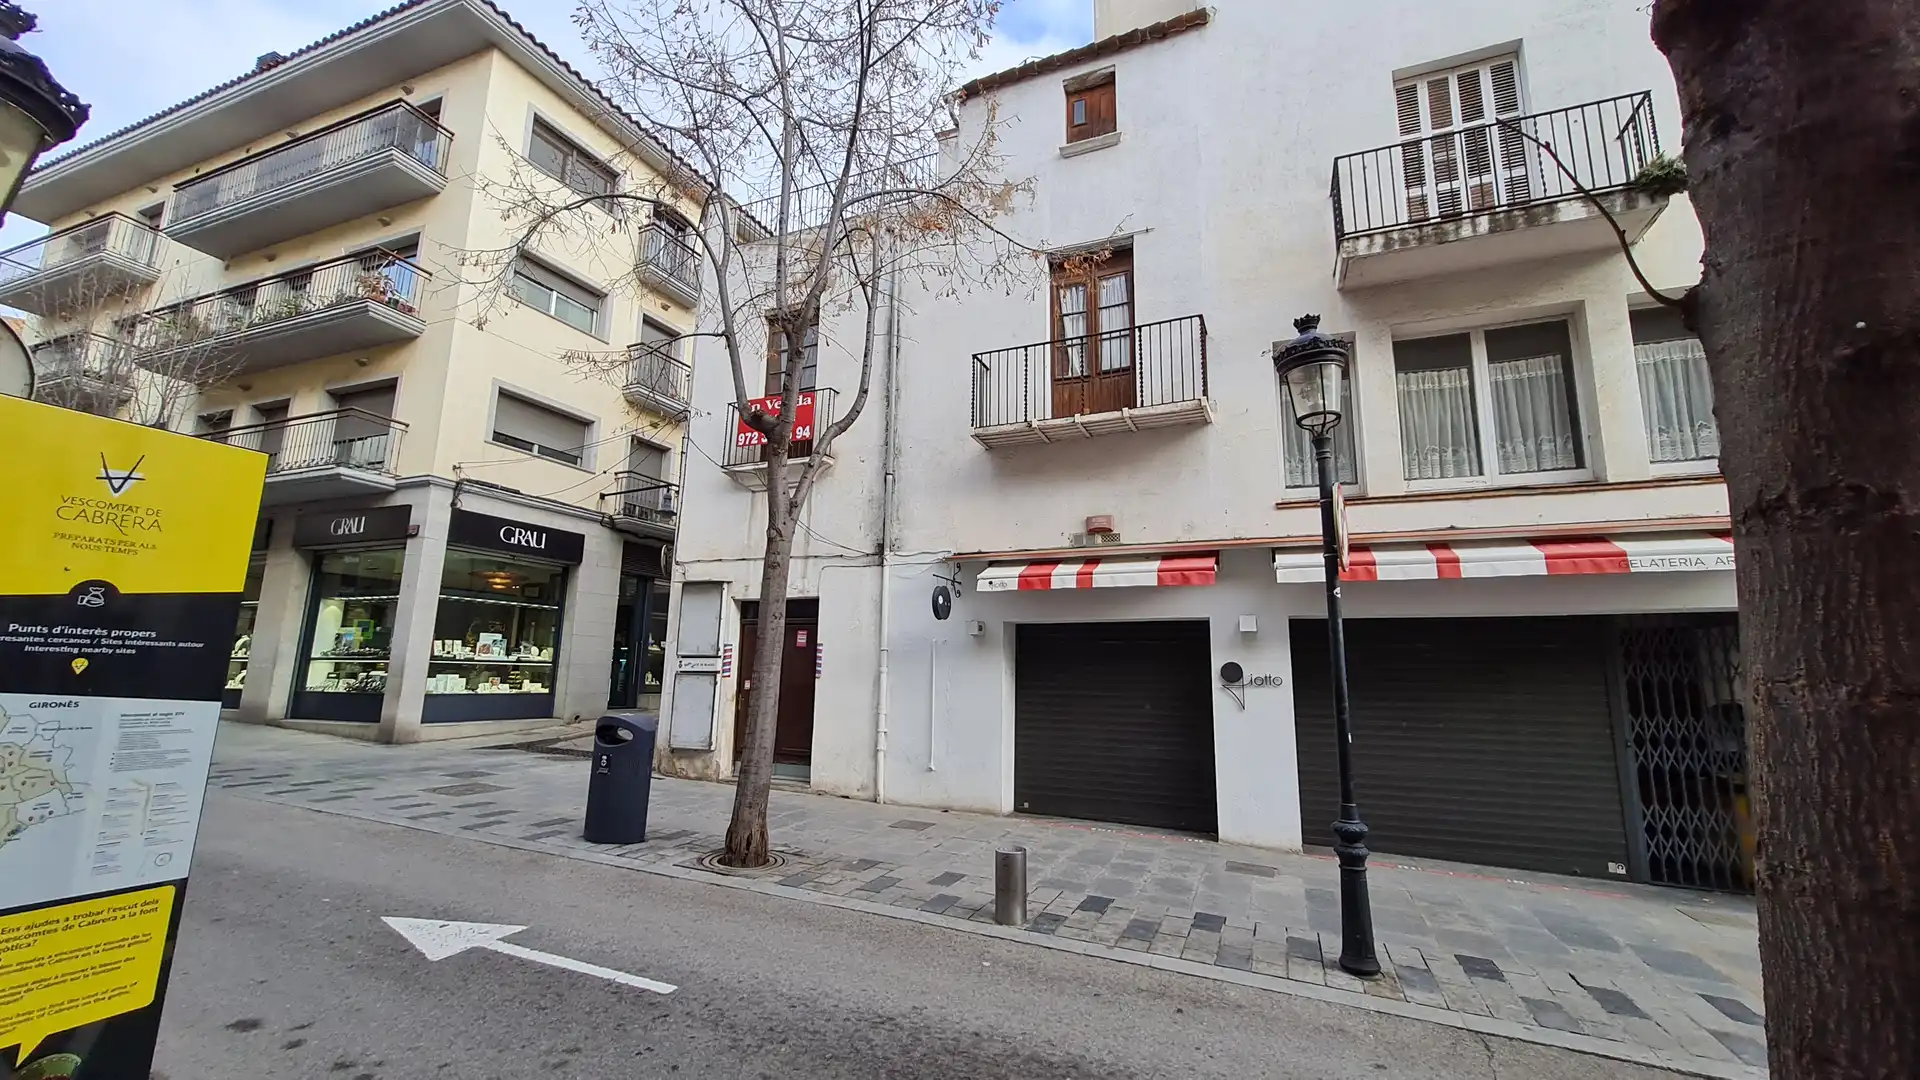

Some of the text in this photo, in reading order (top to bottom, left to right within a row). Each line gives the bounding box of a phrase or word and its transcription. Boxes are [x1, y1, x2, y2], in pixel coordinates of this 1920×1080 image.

[738, 431, 759, 446] 972
[795, 425, 811, 439] 94
[61, 495, 163, 518] VESCOMTAT DE
[56, 504, 163, 536] CABRERA
[330, 516, 366, 535] GRAU
[52, 532, 116, 545] PREPARATS
[118, 539, 138, 548] PER
[500, 525, 547, 549] GRAU
[71, 541, 140, 556] NOUS TEMPS
[1618, 556, 1706, 569] GELATERIA
[8, 623, 157, 639] Punts d'interès propers
[24, 644, 137, 655] Interesting nearby sites
[47, 636, 91, 645] cercanos
[101, 637, 123, 645] Sites
[125, 638, 176, 647] intéressants
[29, 700, 80, 709] GIRONÈS
[1, 898, 160, 936] Ens ajudes a trobar l'escut dels
[61, 922, 76, 932] de
[78, 914, 118, 929] Cabrera
[128, 910, 138, 918] la
[139, 905, 159, 917] font
